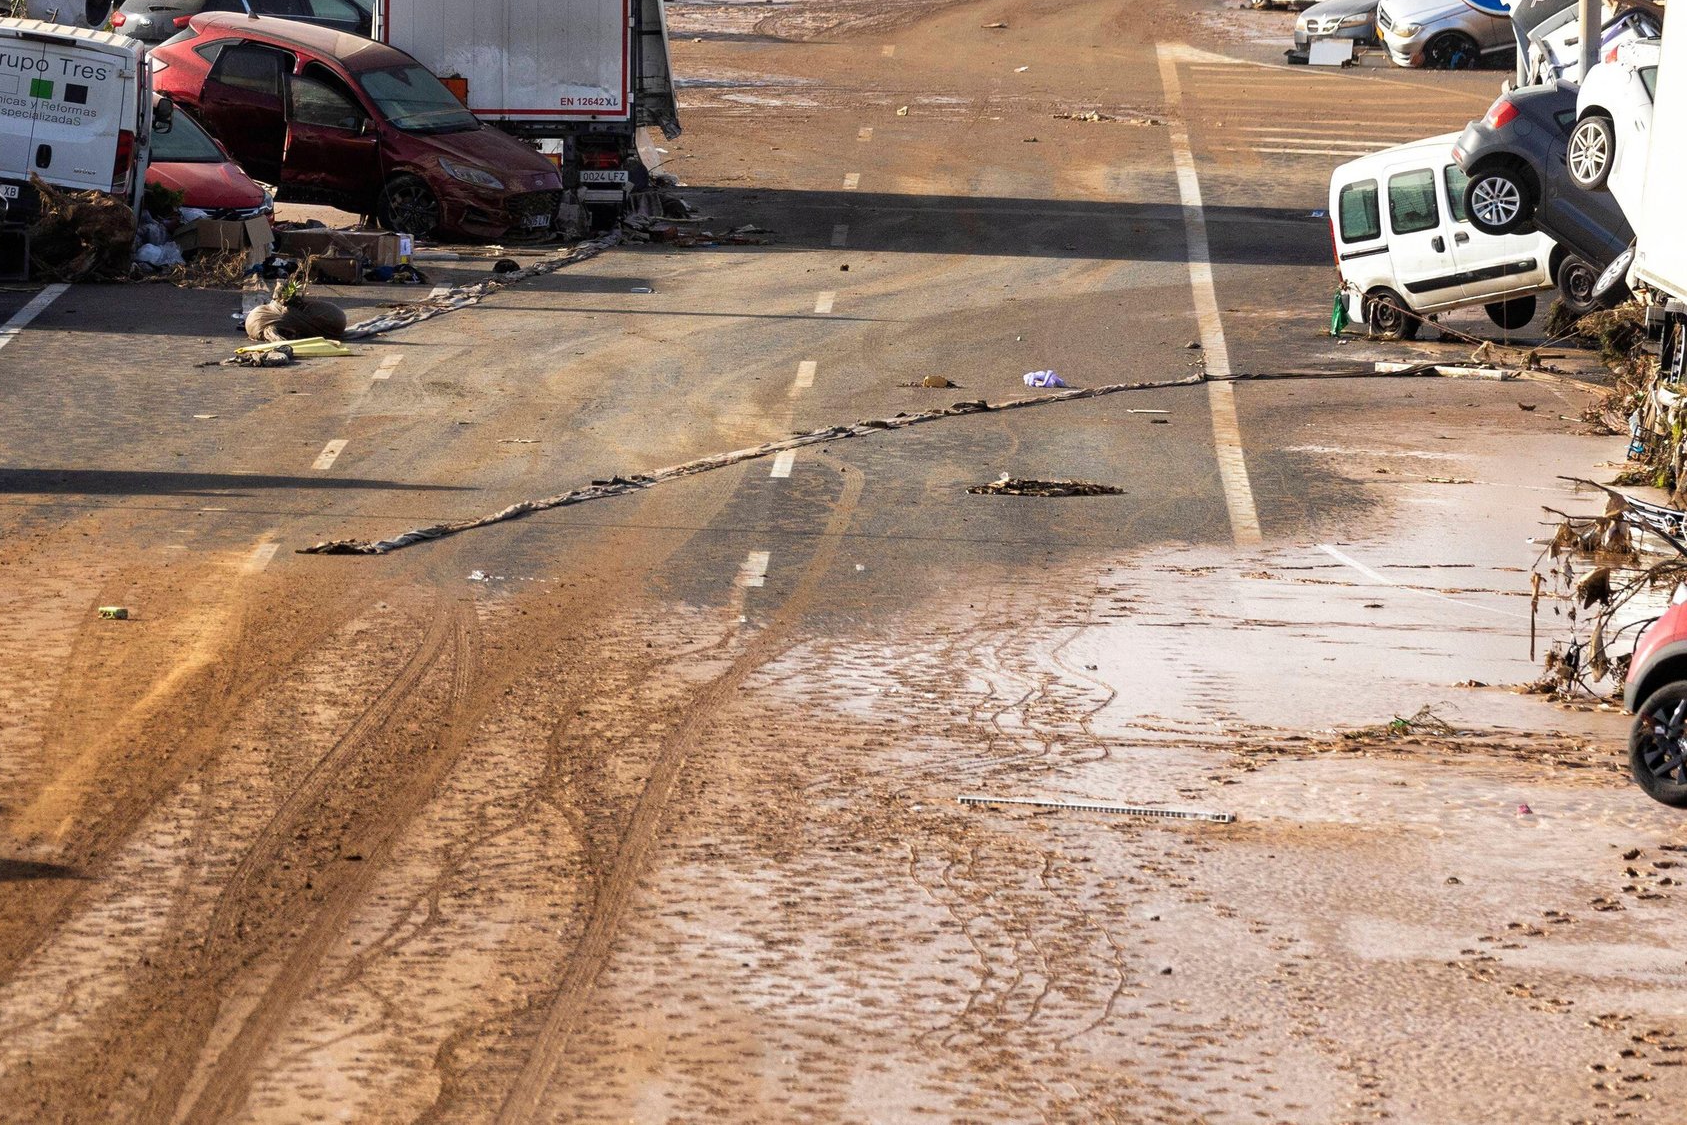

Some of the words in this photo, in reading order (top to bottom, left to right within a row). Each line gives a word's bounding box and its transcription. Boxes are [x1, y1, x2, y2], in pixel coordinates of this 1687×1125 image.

[60, 58, 106, 81] Tres
[41, 101, 97, 117] Reformas
[583, 172, 605, 181] 0024
[608, 172, 625, 181] LFZ
